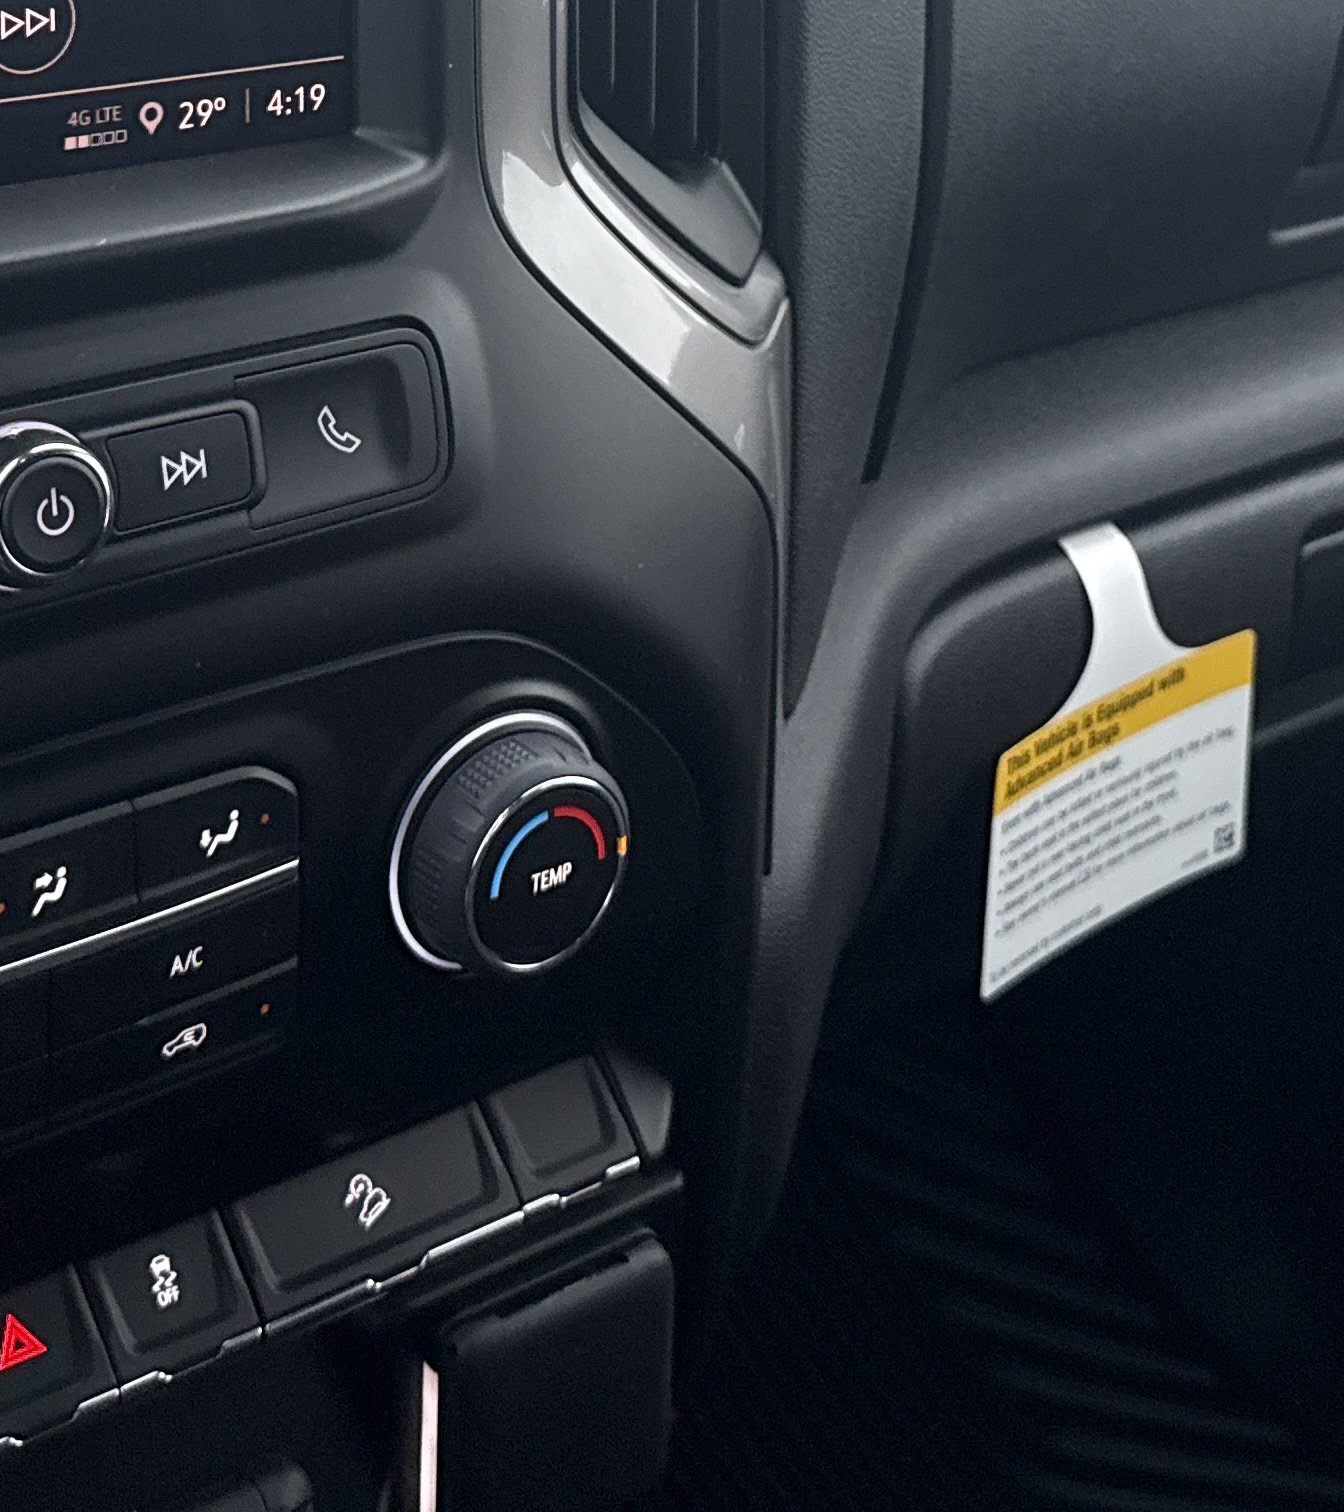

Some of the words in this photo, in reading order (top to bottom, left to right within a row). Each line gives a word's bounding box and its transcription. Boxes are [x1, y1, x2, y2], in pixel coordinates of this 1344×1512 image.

[67, 108, 91, 128] 4G
[94, 104, 123, 125] LTE
[265, 82, 327, 118] 4:19
[530, 860, 574, 895] TEMP
[169, 944, 204, 977] A/C
